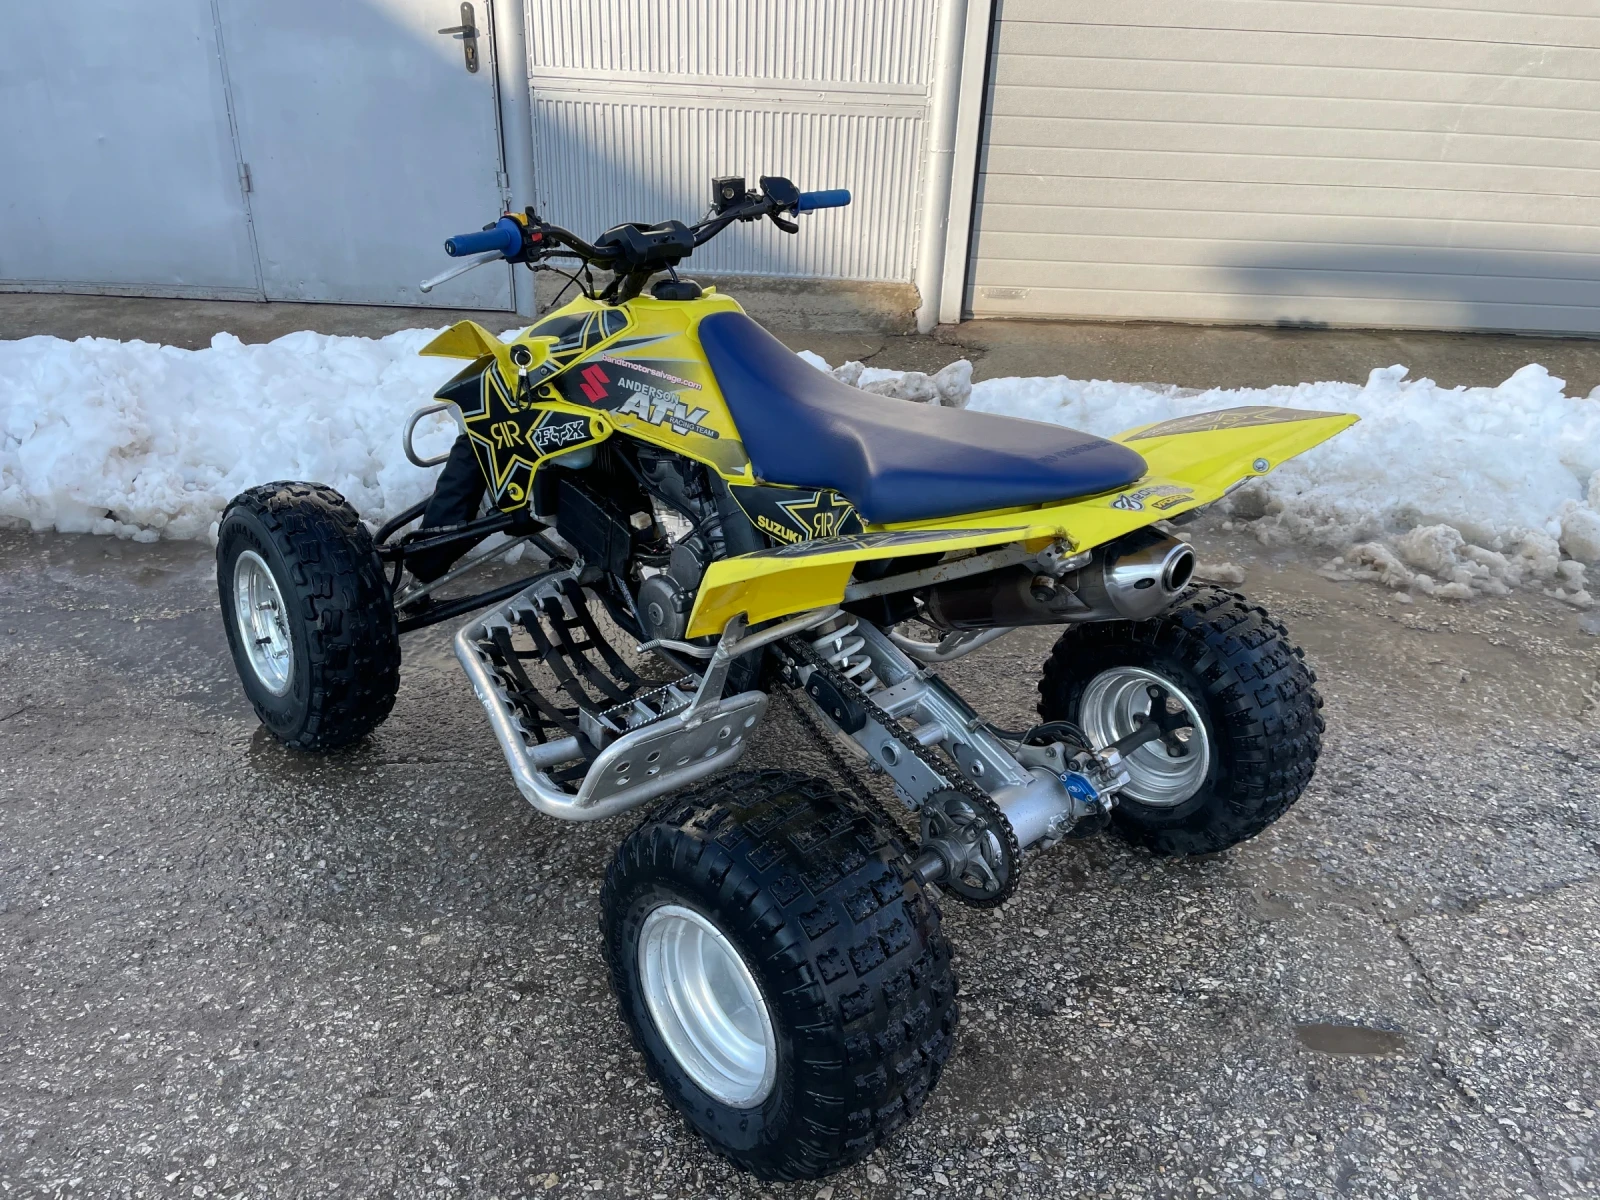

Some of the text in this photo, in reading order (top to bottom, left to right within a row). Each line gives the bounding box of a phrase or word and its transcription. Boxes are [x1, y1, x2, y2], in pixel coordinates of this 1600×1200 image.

[601, 354, 702, 390] bandtmotorsalvage.com
[617, 377, 680, 405] ANDERSON
[617, 392, 710, 436] ATV
[669, 416, 715, 437] RACING TEAM
[757, 515, 803, 543] SUZUKI
